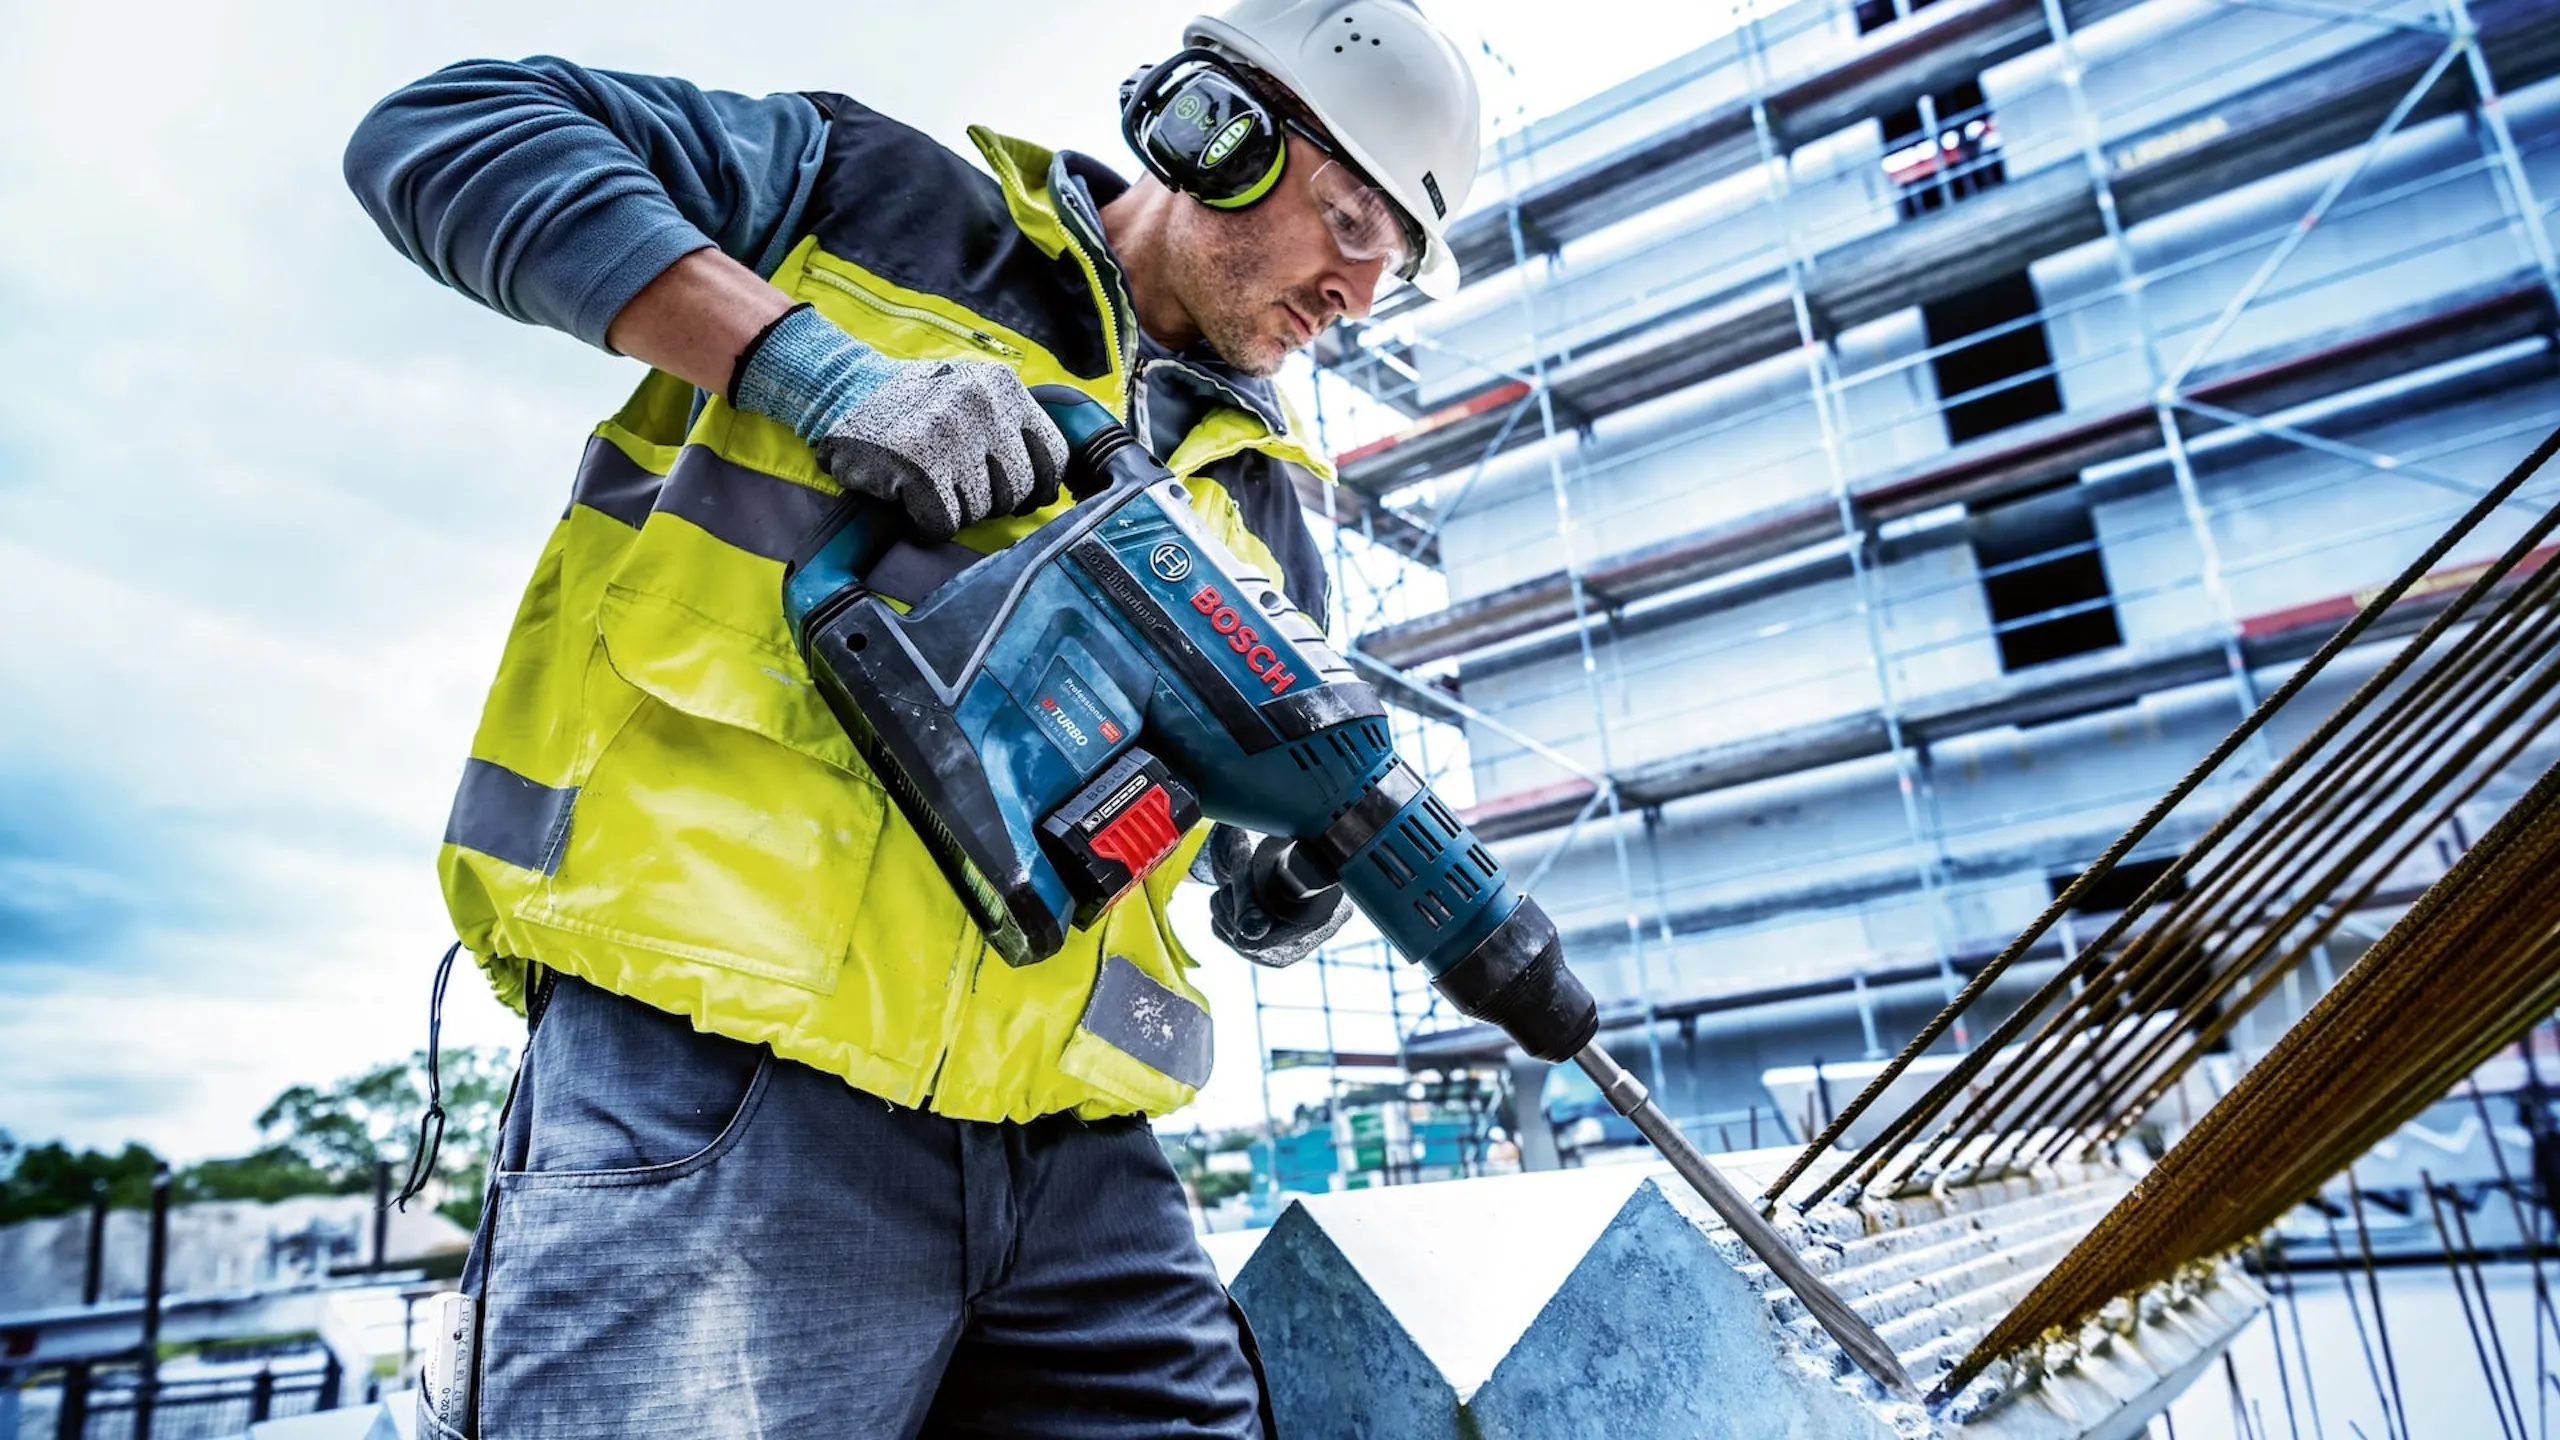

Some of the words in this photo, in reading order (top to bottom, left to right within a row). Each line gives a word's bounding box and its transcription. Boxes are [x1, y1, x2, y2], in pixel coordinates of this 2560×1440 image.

[1209, 120, 1248, 160] QED
[1190, 584, 1297, 696] BOSCH
[1064, 676, 1106, 722] Professional
[1084, 761, 1134, 802] BOSCH
